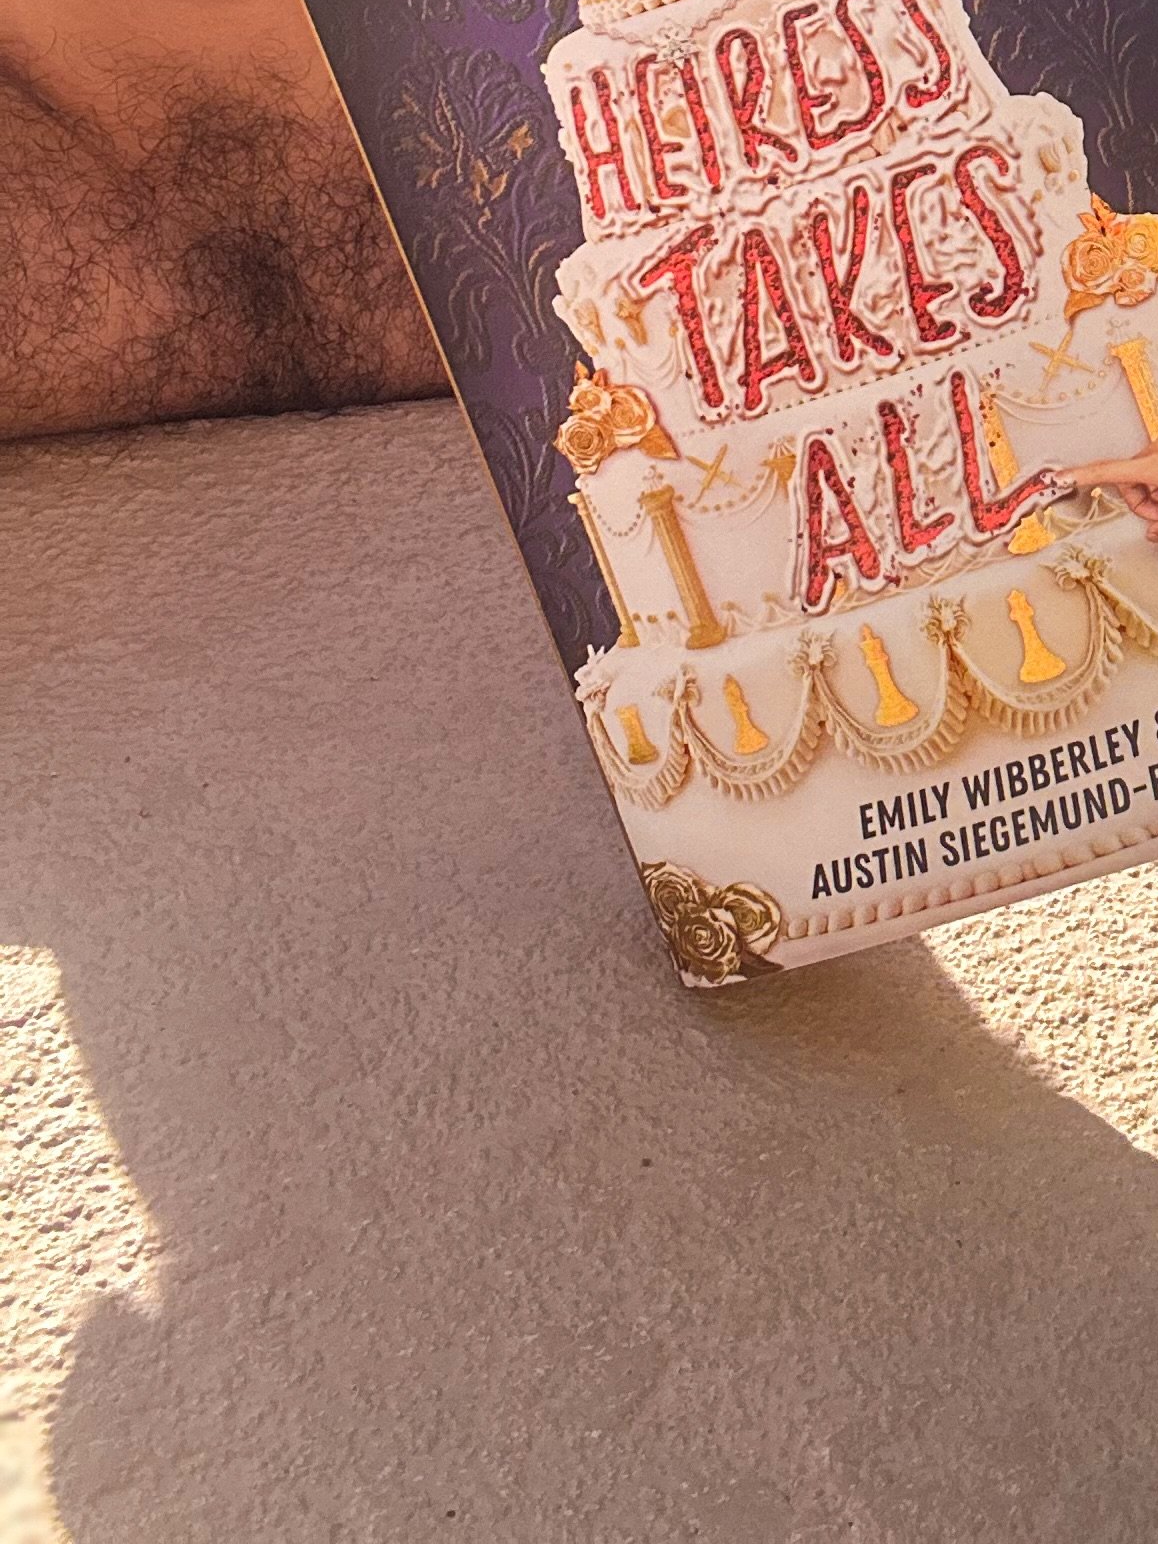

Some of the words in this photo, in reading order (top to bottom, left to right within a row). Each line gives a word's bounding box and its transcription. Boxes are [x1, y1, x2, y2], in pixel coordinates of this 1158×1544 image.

[640, 146, 1026, 410] TAKES
[806, 371, 1057, 606] ALL
[811, 837, 930, 900] AUSTIN
[858, 781, 951, 840] EMILY
[961, 719, 1142, 811] WIBBERLEY
